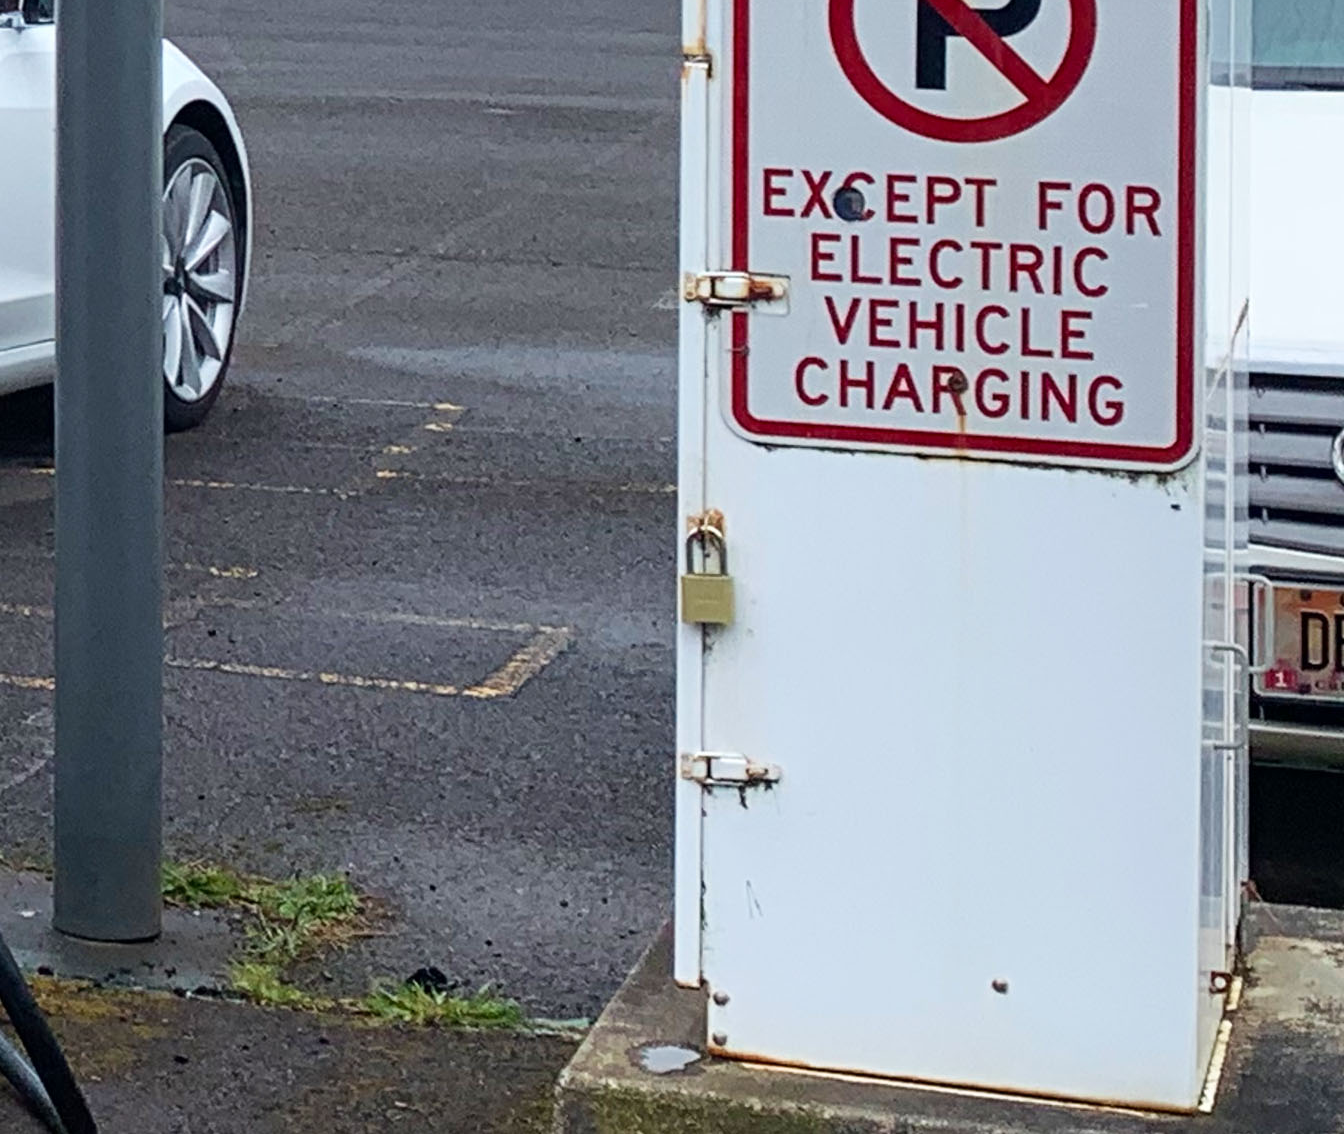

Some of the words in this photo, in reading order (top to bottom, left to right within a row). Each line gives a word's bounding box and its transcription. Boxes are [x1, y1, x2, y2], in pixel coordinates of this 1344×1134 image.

[762, 168, 997, 226] EXCEPT
[1038, 181, 1162, 237] FOR
[810, 232, 1109, 298] ELECTRIC
[824, 295, 1094, 361] VEHICLE
[794, 356, 1124, 426] CHARGING
[1275, 672, 1287, 687] 1
